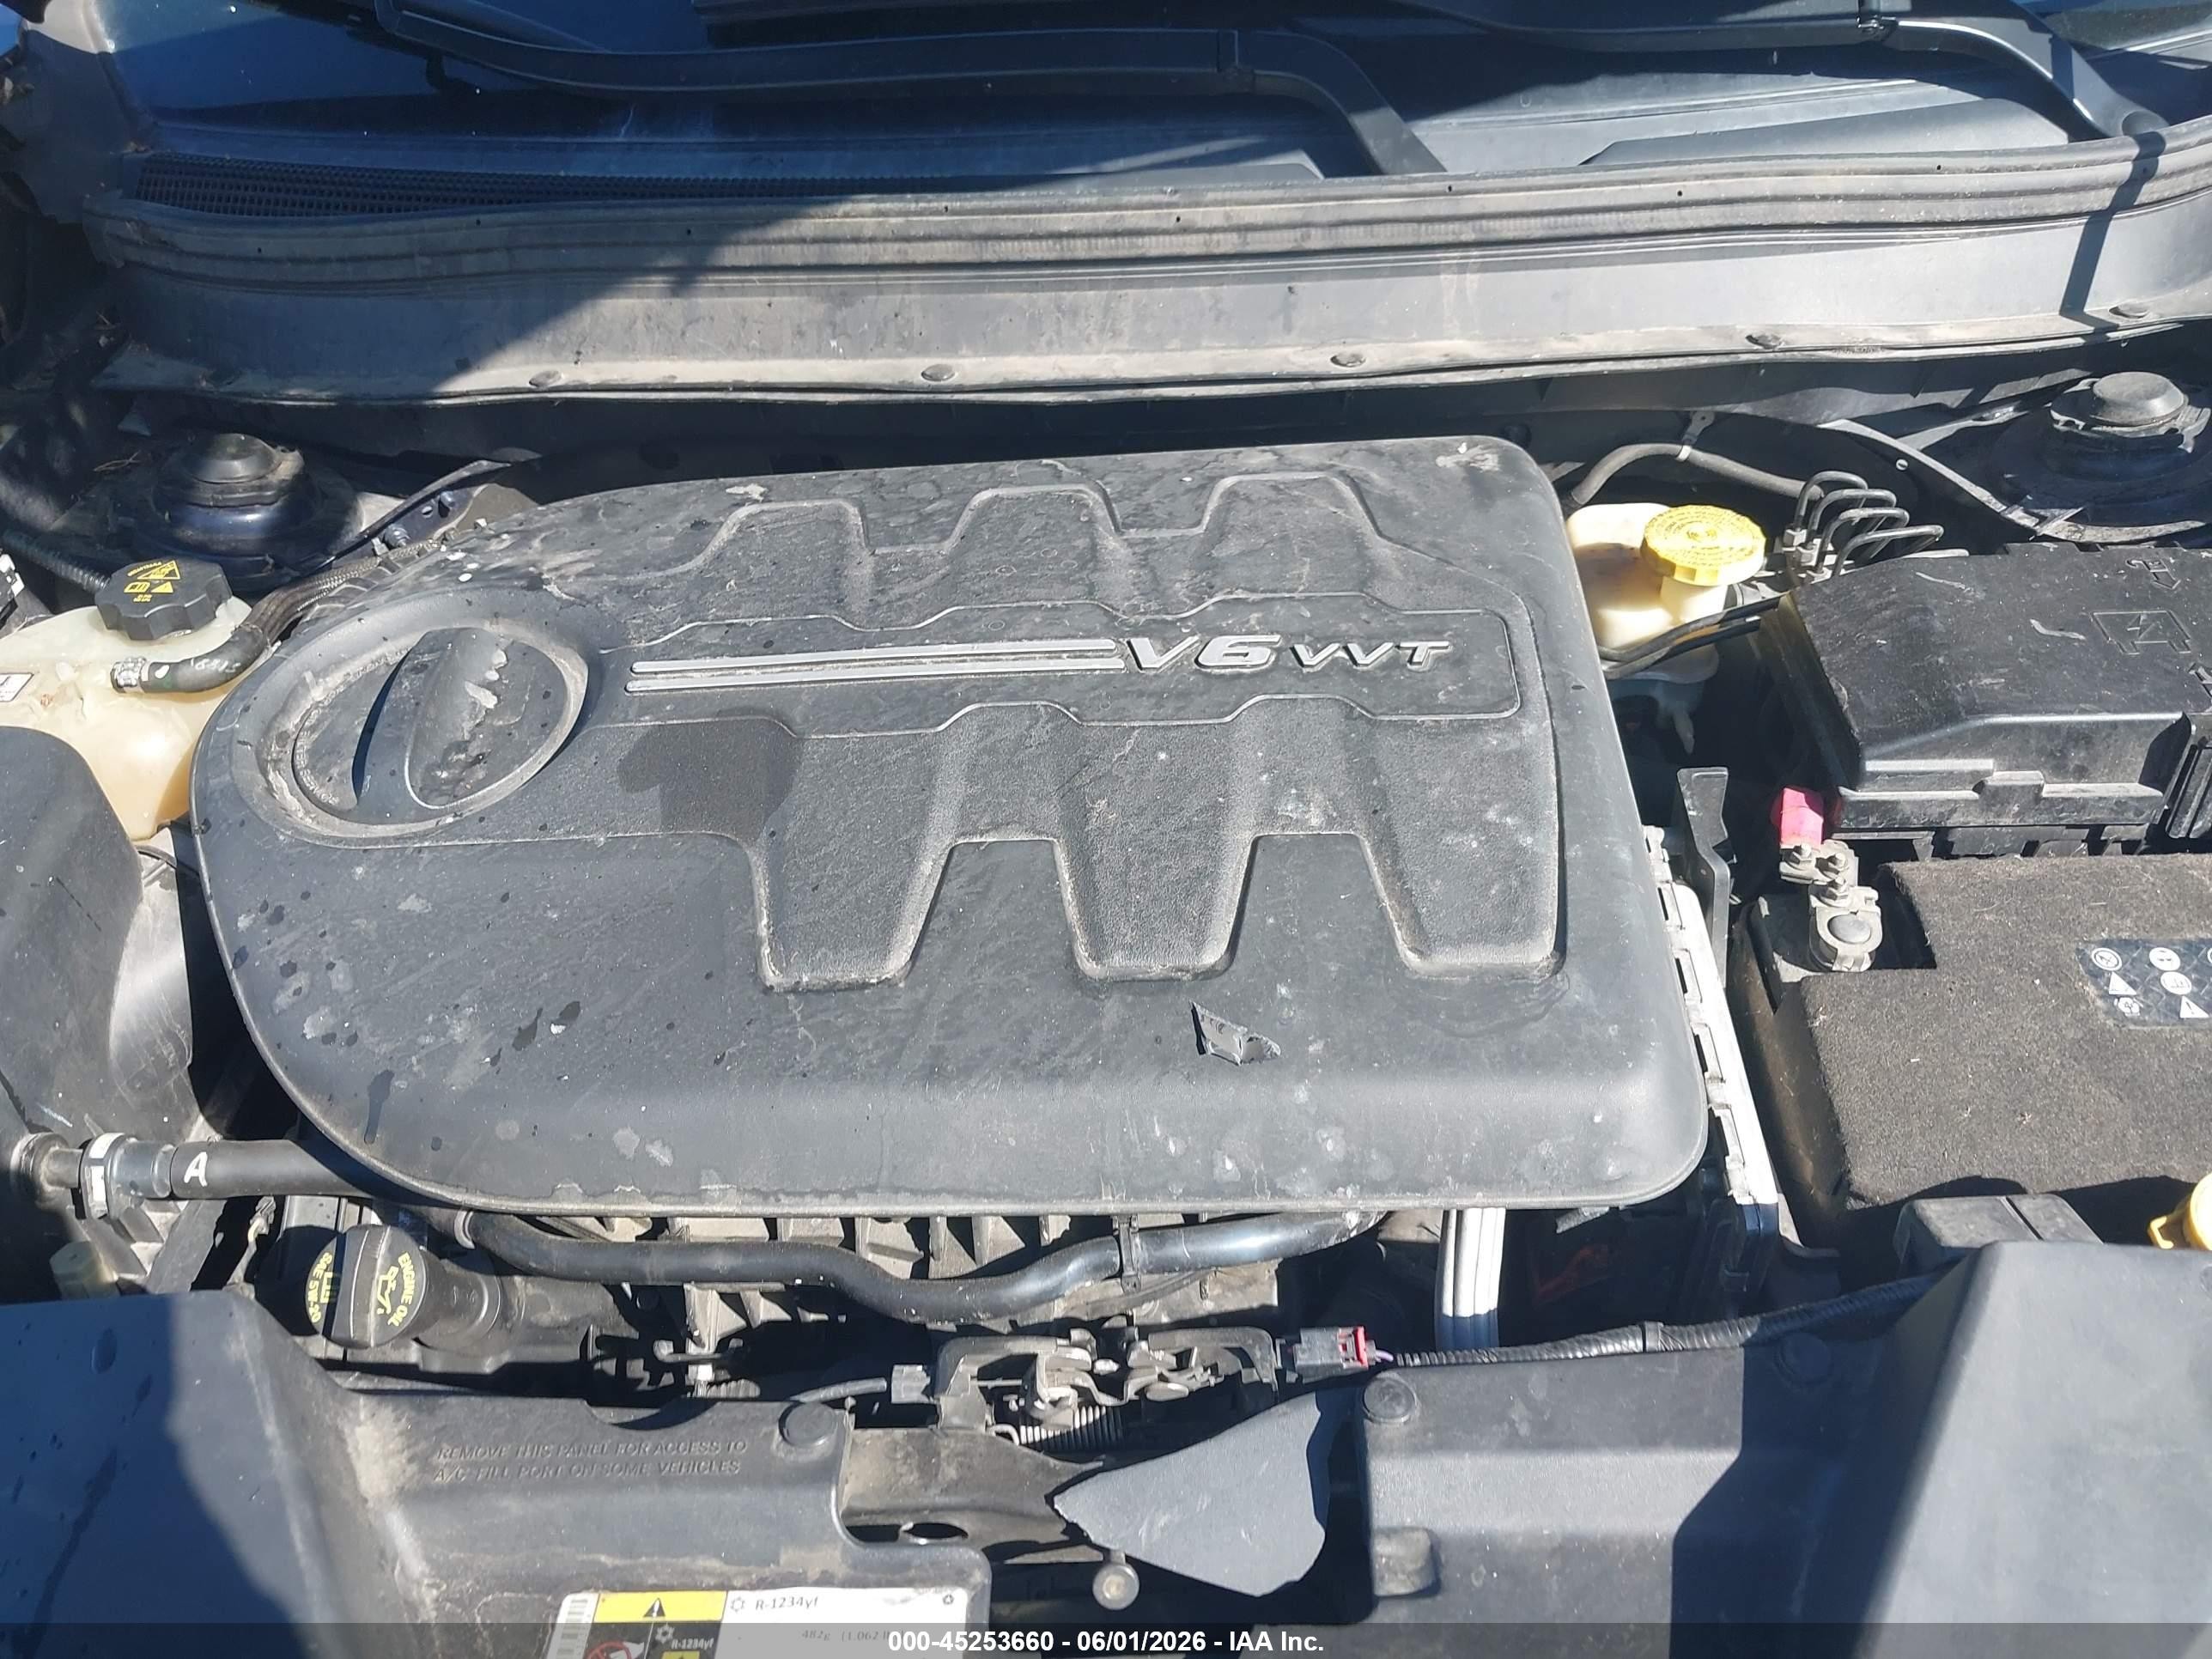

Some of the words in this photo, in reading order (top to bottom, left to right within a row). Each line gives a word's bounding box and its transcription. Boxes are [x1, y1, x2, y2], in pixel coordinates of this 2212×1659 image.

[1127, 635, 1283, 672] V6
[1290, 640, 1451, 672] VVT
[183, 1151, 210, 1188] A
[313, 1252, 333, 1279] SAE
[398, 1252, 416, 1305] ENGINE
[307, 1279, 322, 1323] 5W-20
[387, 1304, 408, 1327] OIL
[437, 1444, 511, 1462] REMOVE
[516, 1443, 554, 1459] THIS
[557, 1442, 611, 1459] PANEL
[617, 1442, 652, 1456] FOR
[653, 1441, 722, 1456] ACCESS
[727, 1440, 748, 1455] TO
[434, 1464, 468, 1483] A/C
[477, 1465, 510, 1481] FILL
[517, 1463, 563, 1480] PORT
[569, 1462, 599, 1478] ON
[602, 1462, 652, 1478] SOME
[659, 1460, 741, 1476] VEHICLES
